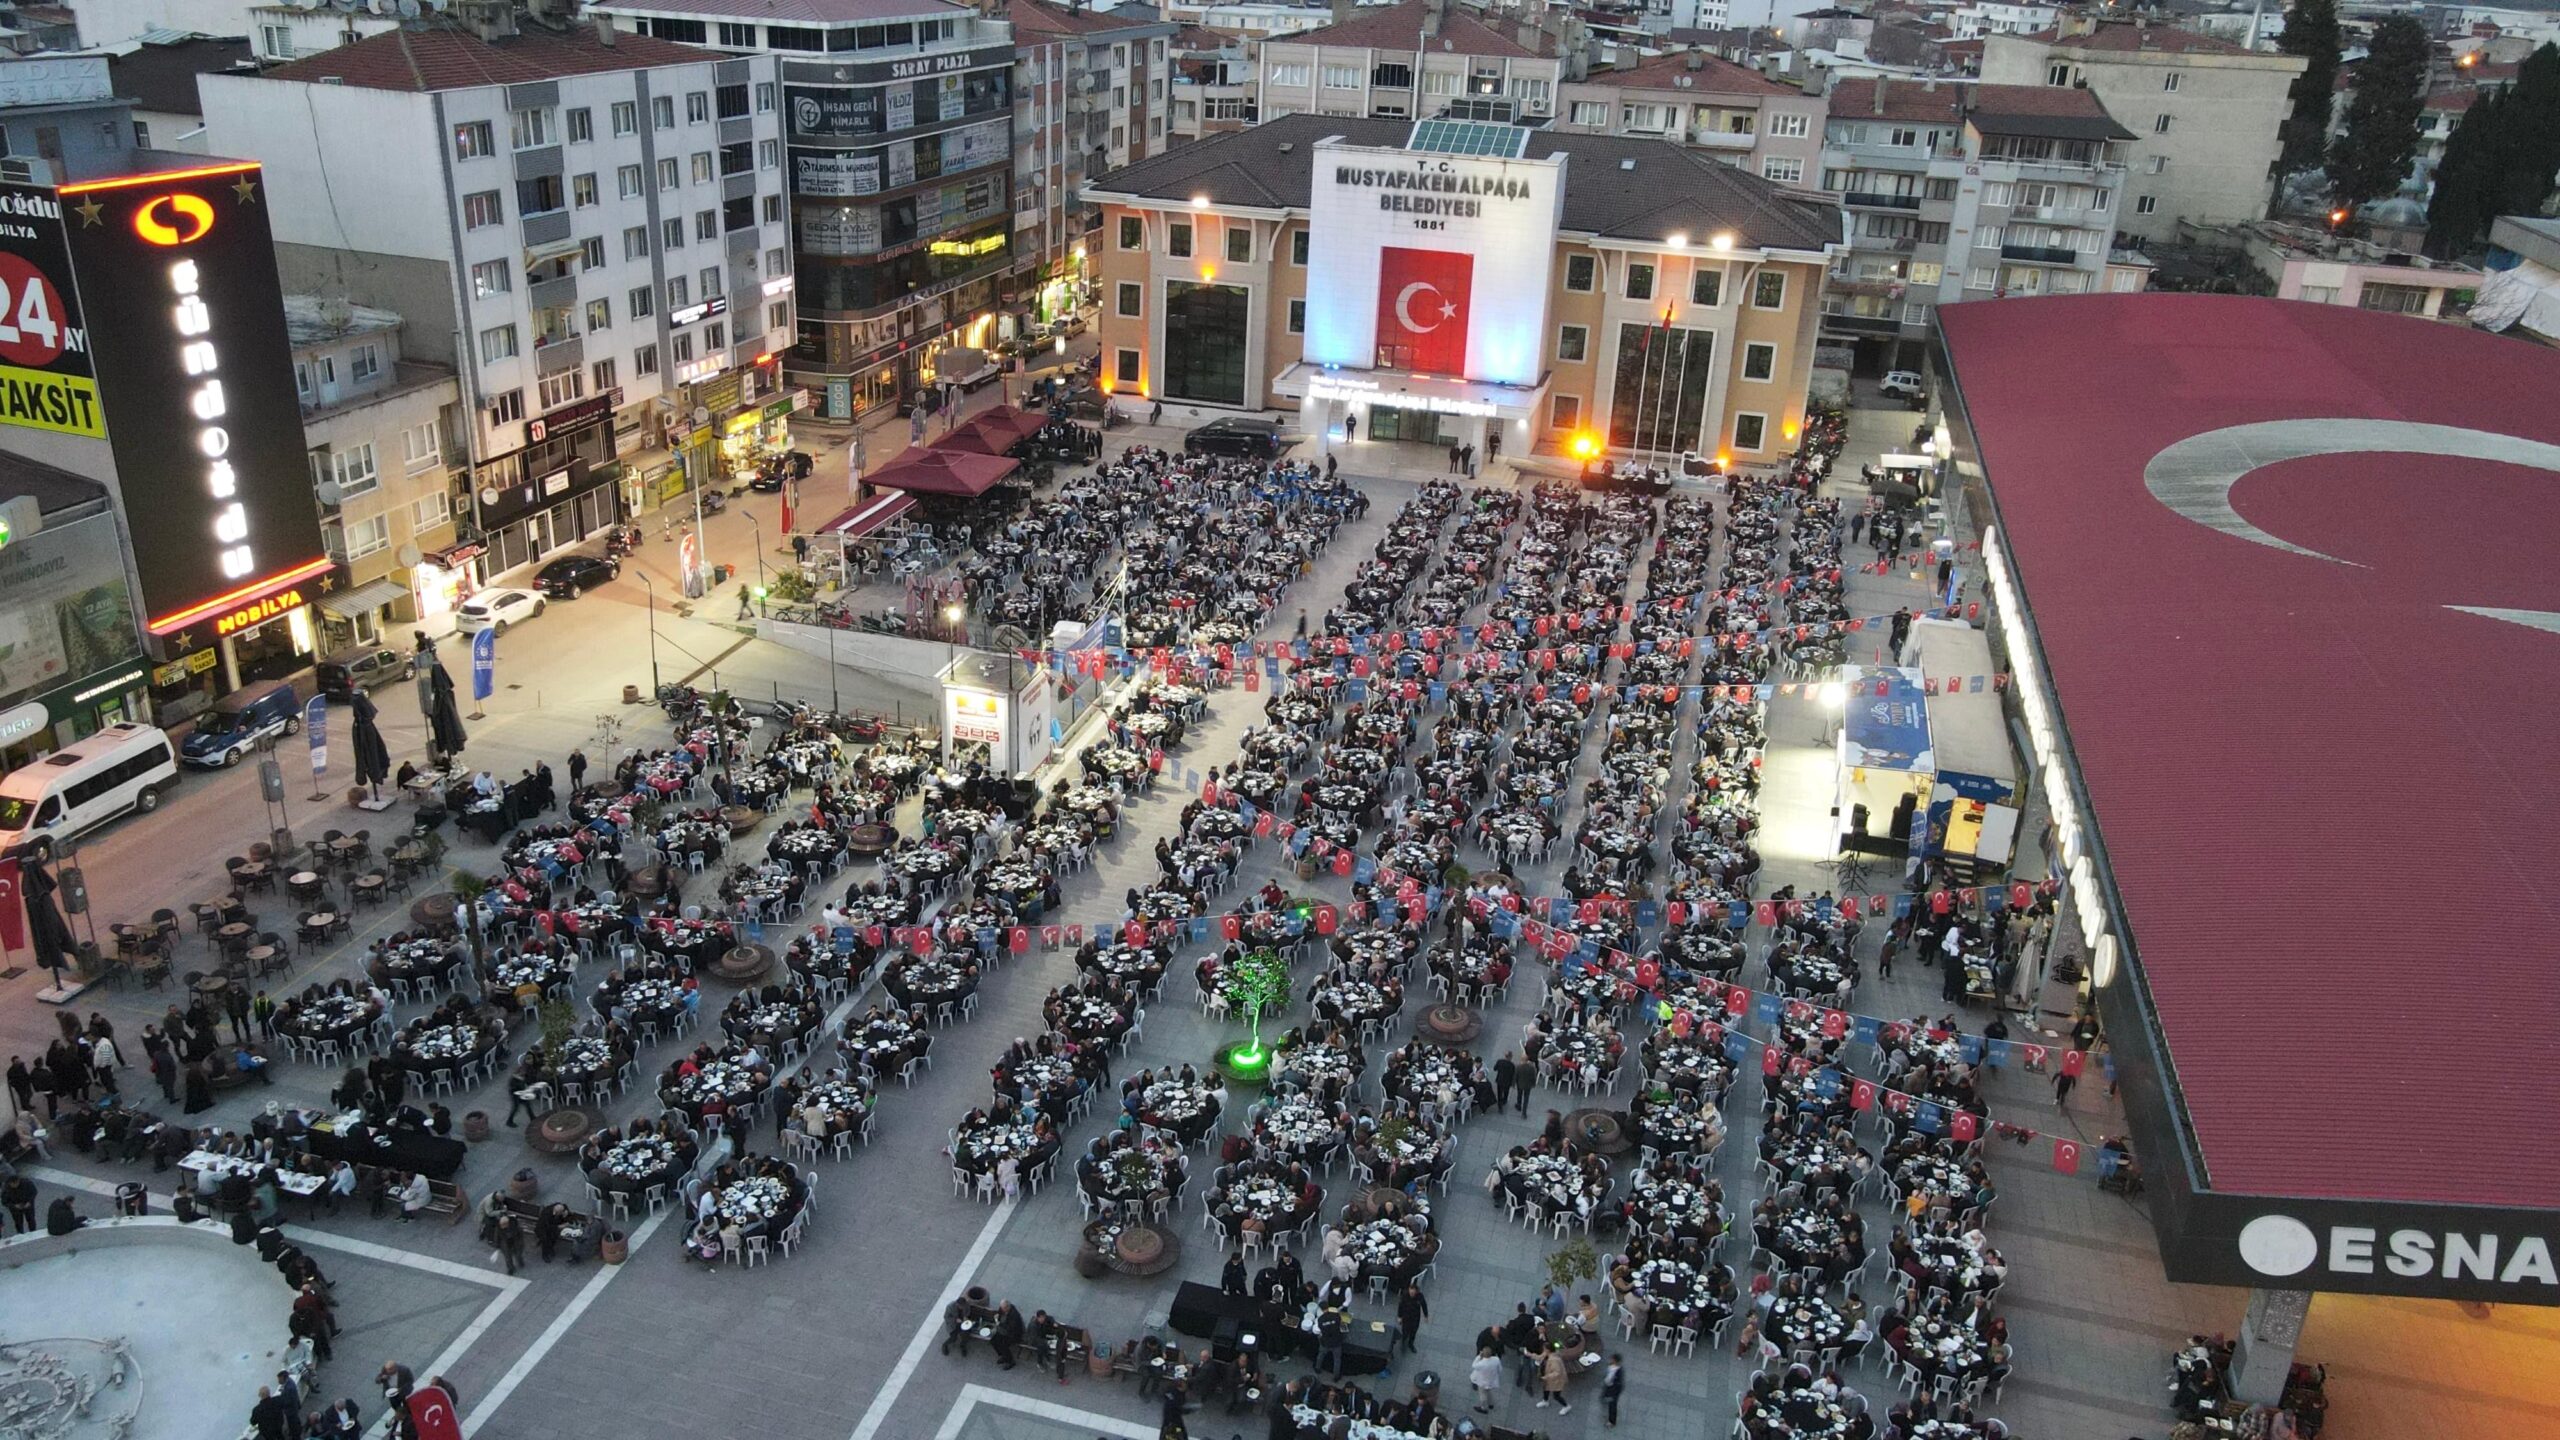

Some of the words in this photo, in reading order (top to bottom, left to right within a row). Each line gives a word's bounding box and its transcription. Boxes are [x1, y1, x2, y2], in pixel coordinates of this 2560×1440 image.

[892, 60, 930, 78] SARAY
[937, 54, 971, 71] PLAZA
[1335, 166, 1531, 202] MUSTAFAKEMALPAŞA
[0, 191, 61, 219] oğdu
[1412, 219, 1445, 231] 1881
[64, 326, 85, 353] AY
[217, 590, 302, 635] MOBİLYA
[2327, 1225, 2560, 1285] ESNA
